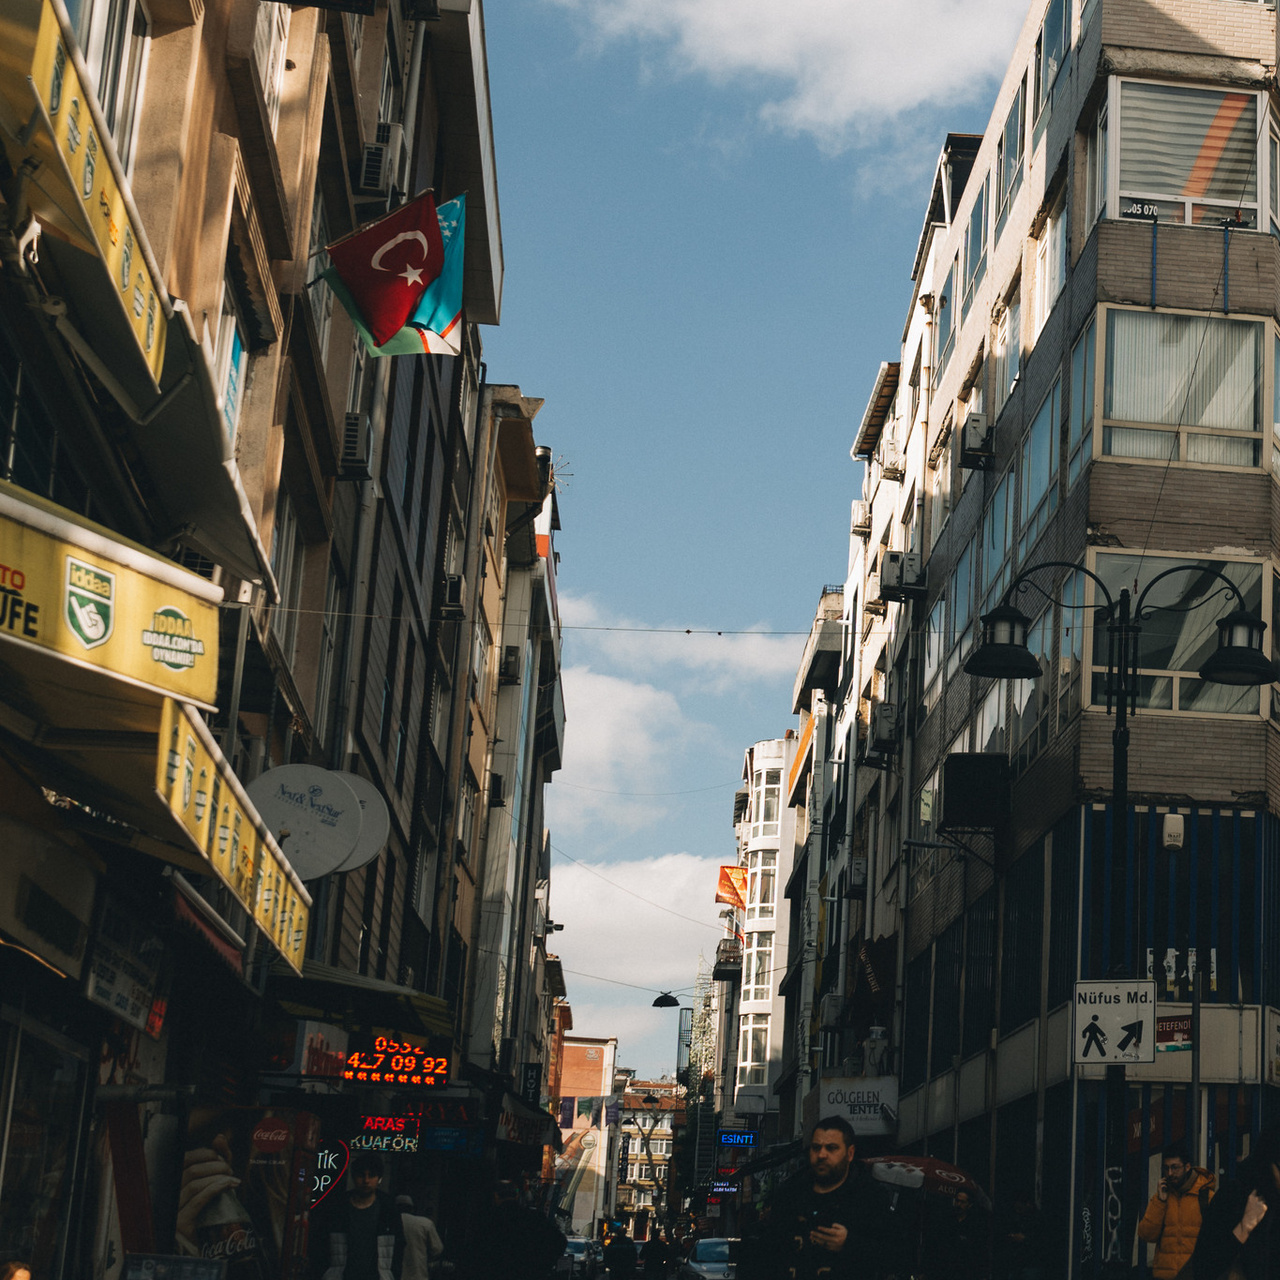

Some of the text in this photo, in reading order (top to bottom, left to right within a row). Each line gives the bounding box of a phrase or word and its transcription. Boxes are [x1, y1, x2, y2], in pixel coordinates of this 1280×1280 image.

[70, 564, 111, 598] iddaa
[1078, 991, 1153, 1004] Nüfus Md.
[391, 1055, 416, 1071] 09
[422, 1057, 447, 1074] 92
[827, 1089, 880, 1104] GÖLGELEN
[363, 1117, 405, 1131] ARAS
[721, 1134, 753, 1144] ESİNTİ
